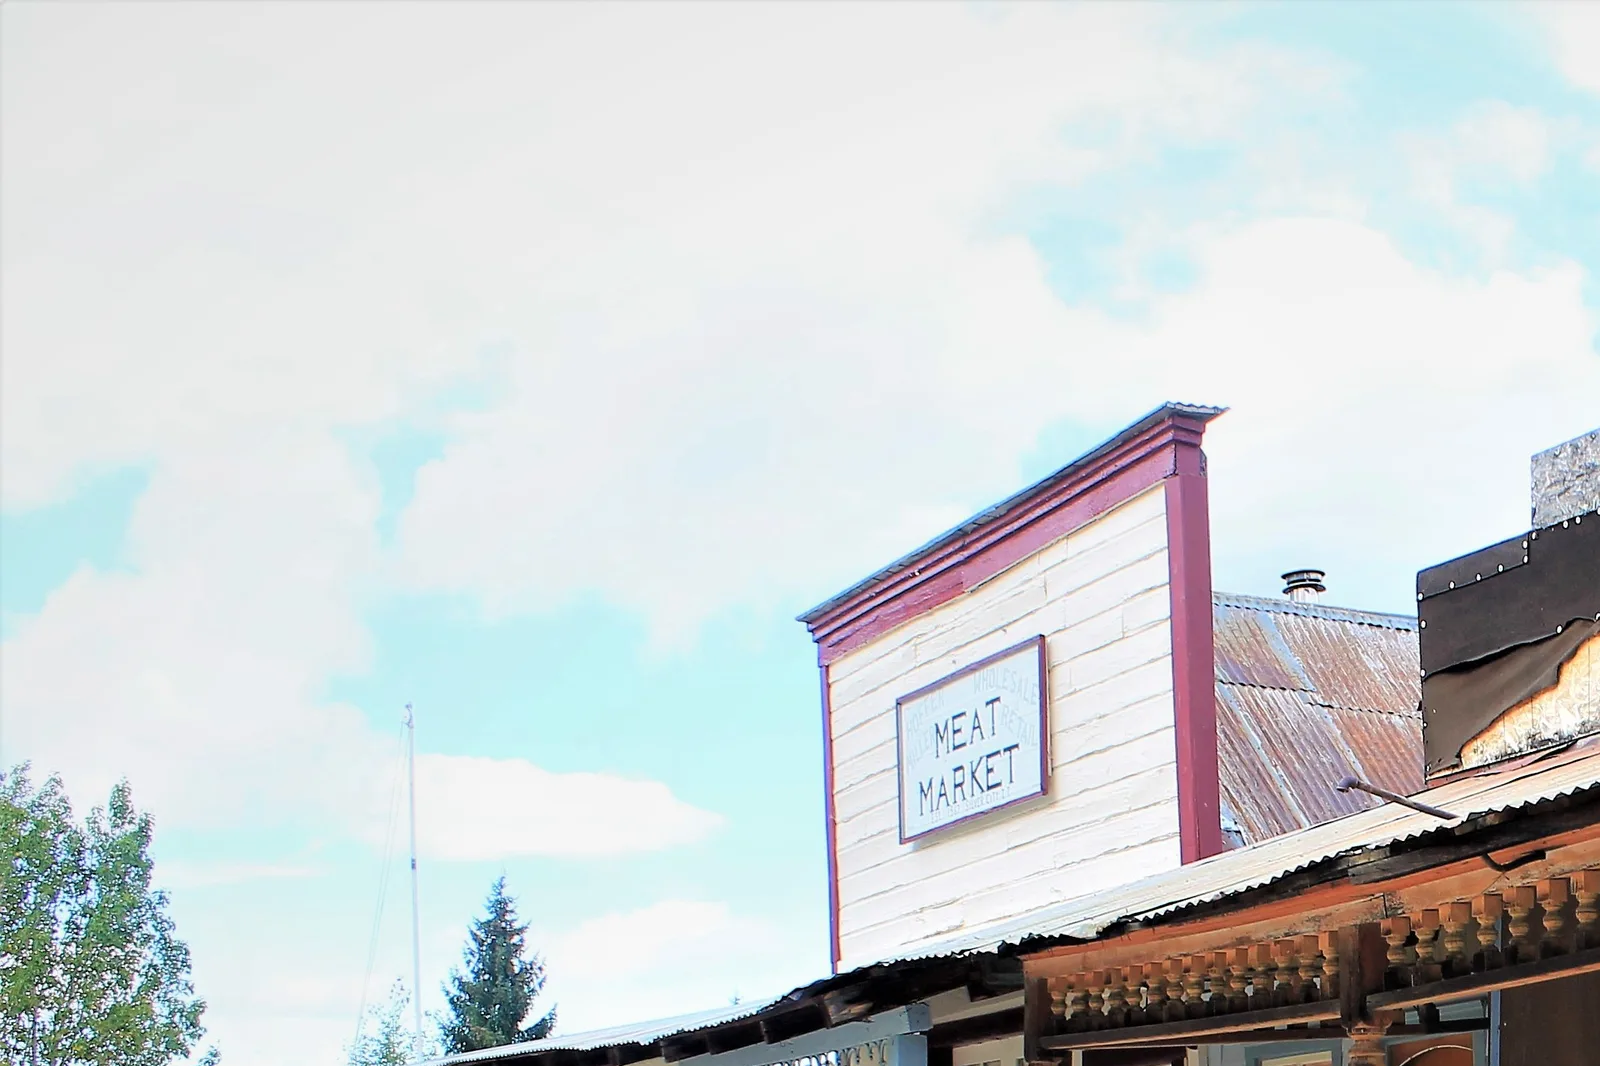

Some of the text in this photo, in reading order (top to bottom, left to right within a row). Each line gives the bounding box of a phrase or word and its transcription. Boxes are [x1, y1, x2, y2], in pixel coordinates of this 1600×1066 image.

[972, 667, 1039, 705] WHOLESALE
[934, 696, 1001, 759] MEAT
[1000, 704, 1038, 746] RETAIL
[919, 743, 1020, 816] MARKET
